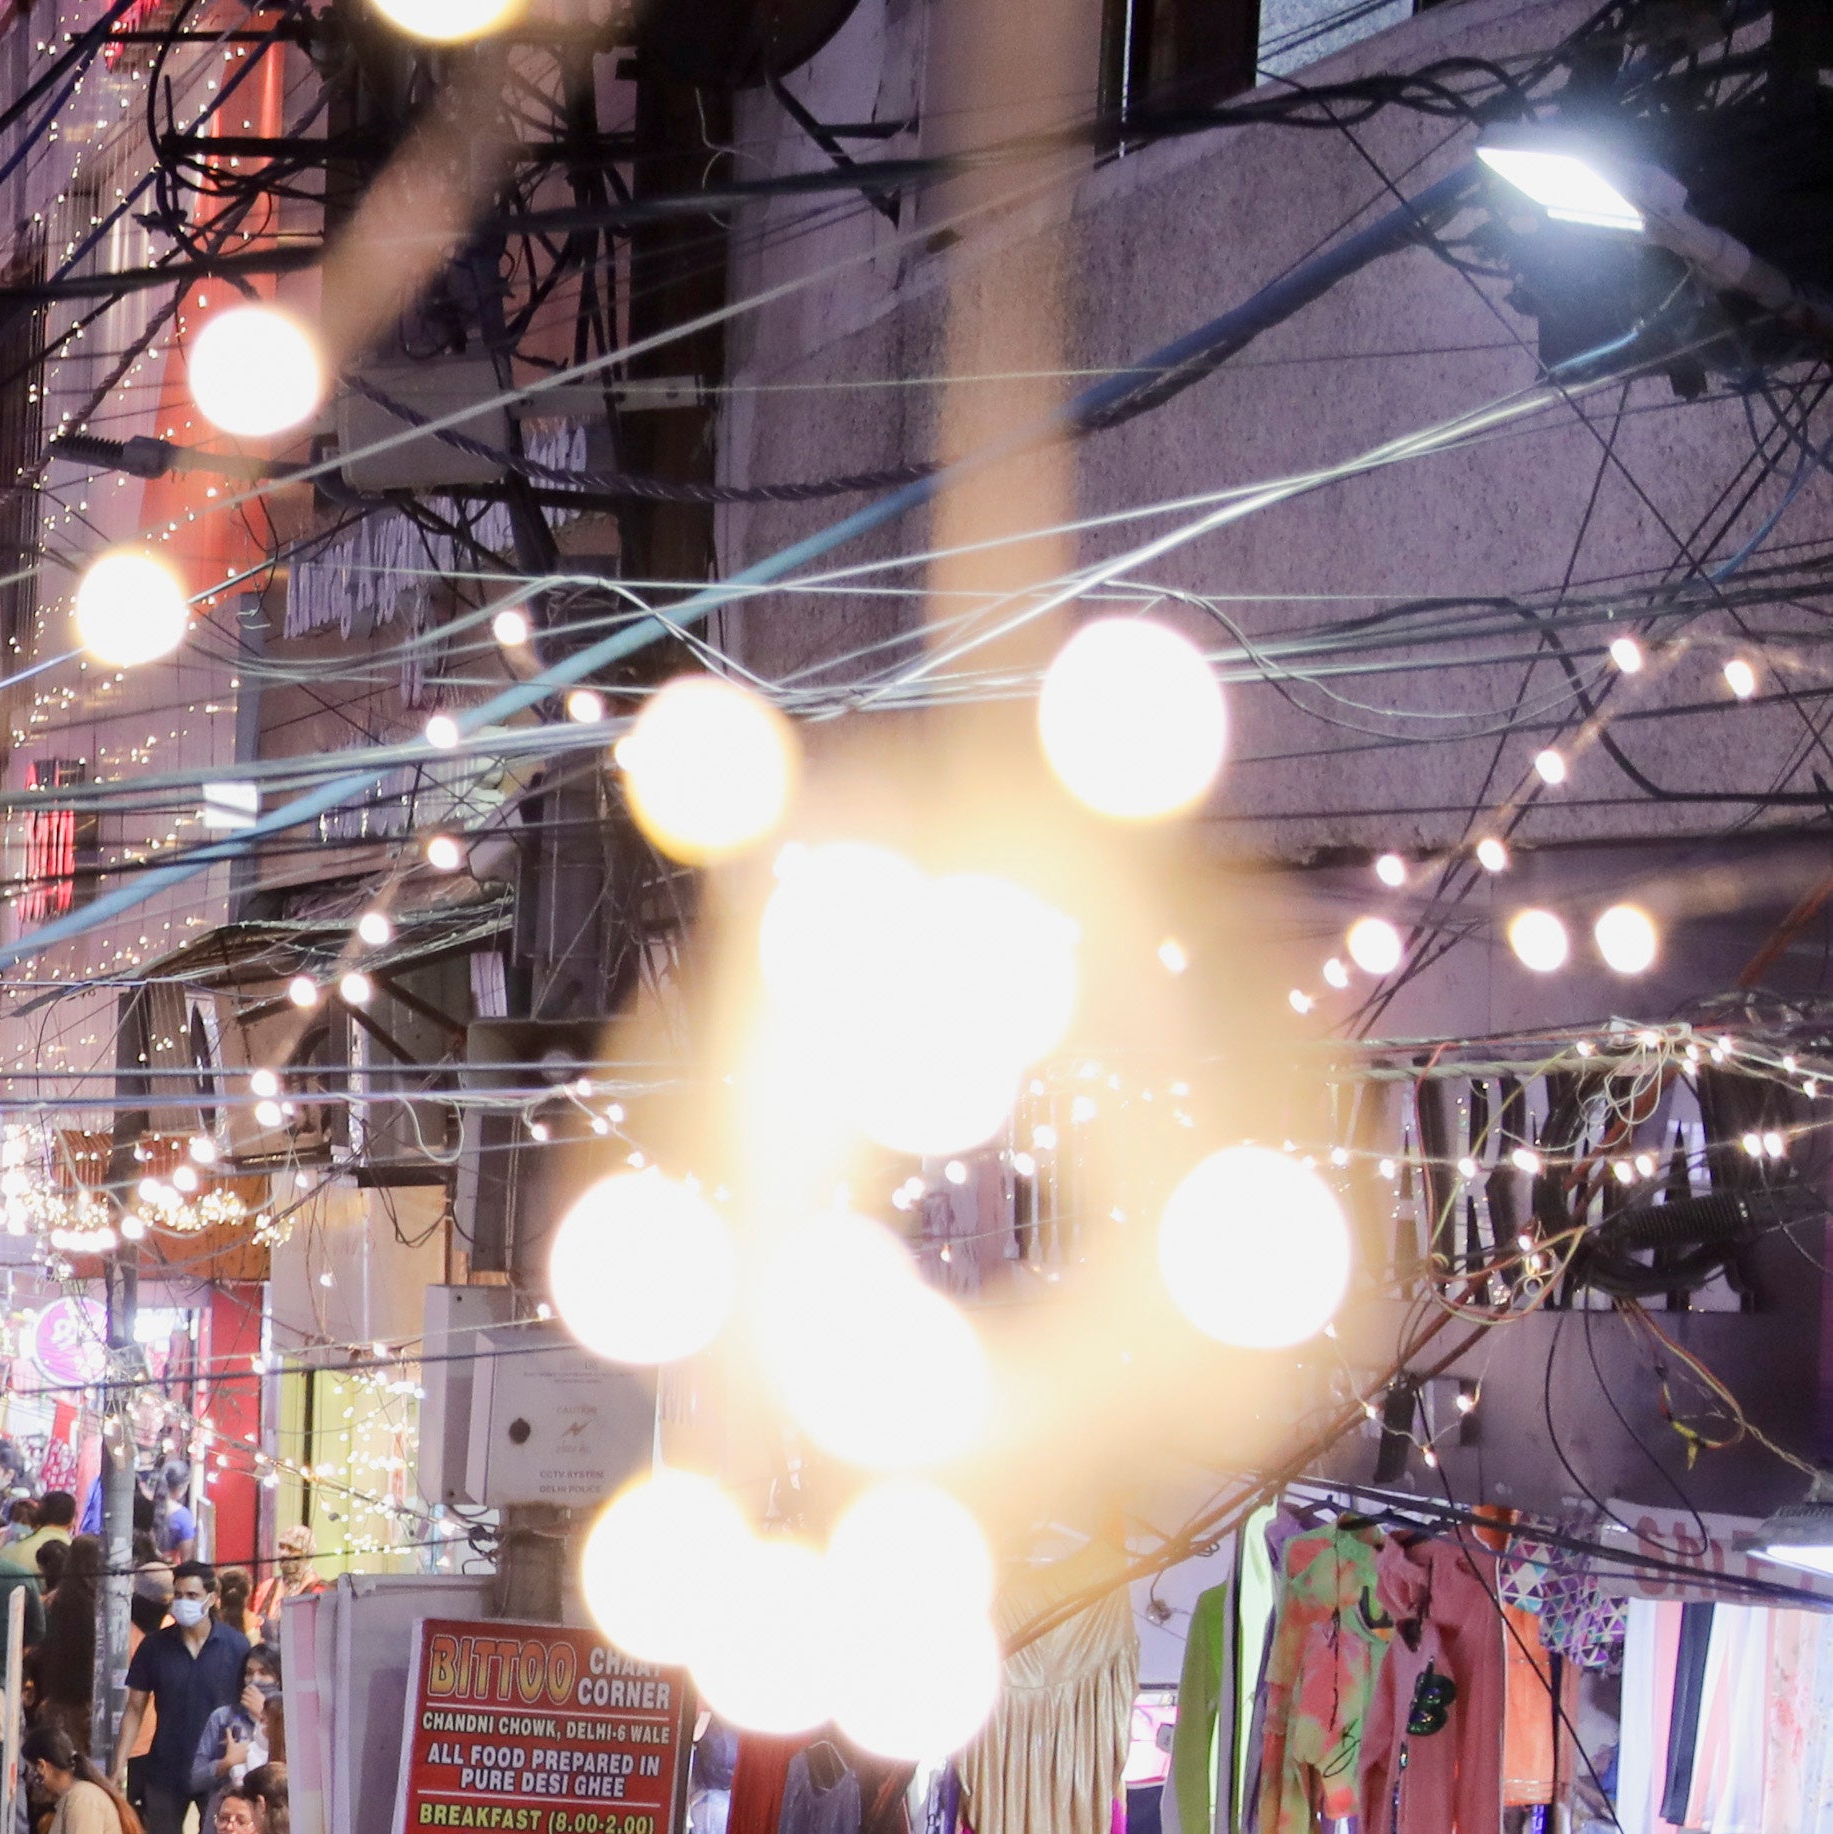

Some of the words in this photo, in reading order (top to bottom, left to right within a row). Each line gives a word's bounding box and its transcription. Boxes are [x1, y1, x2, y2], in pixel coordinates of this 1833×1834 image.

[428, 1634, 576, 1705] BITTOO
[577, 1677, 671, 1710] CORNER
[423, 1711, 493, 1734] CHANDNI
[499, 1717, 561, 1742] CHOWK,
[566, 1721, 626, 1743] DELHI-6
[630, 1726, 670, 1745] WALE
[428, 1742, 464, 1765] ALL
[471, 1745, 525, 1769] FOOD
[532, 1748, 634, 1775] PREPARED
[639, 1755, 660, 1777] IN
[461, 1768, 515, 1792] PURE
[521, 1772, 568, 1795] DESI
[574, 1776, 625, 1798] GHEE
[419, 1803, 541, 1831] BREAKFAST
